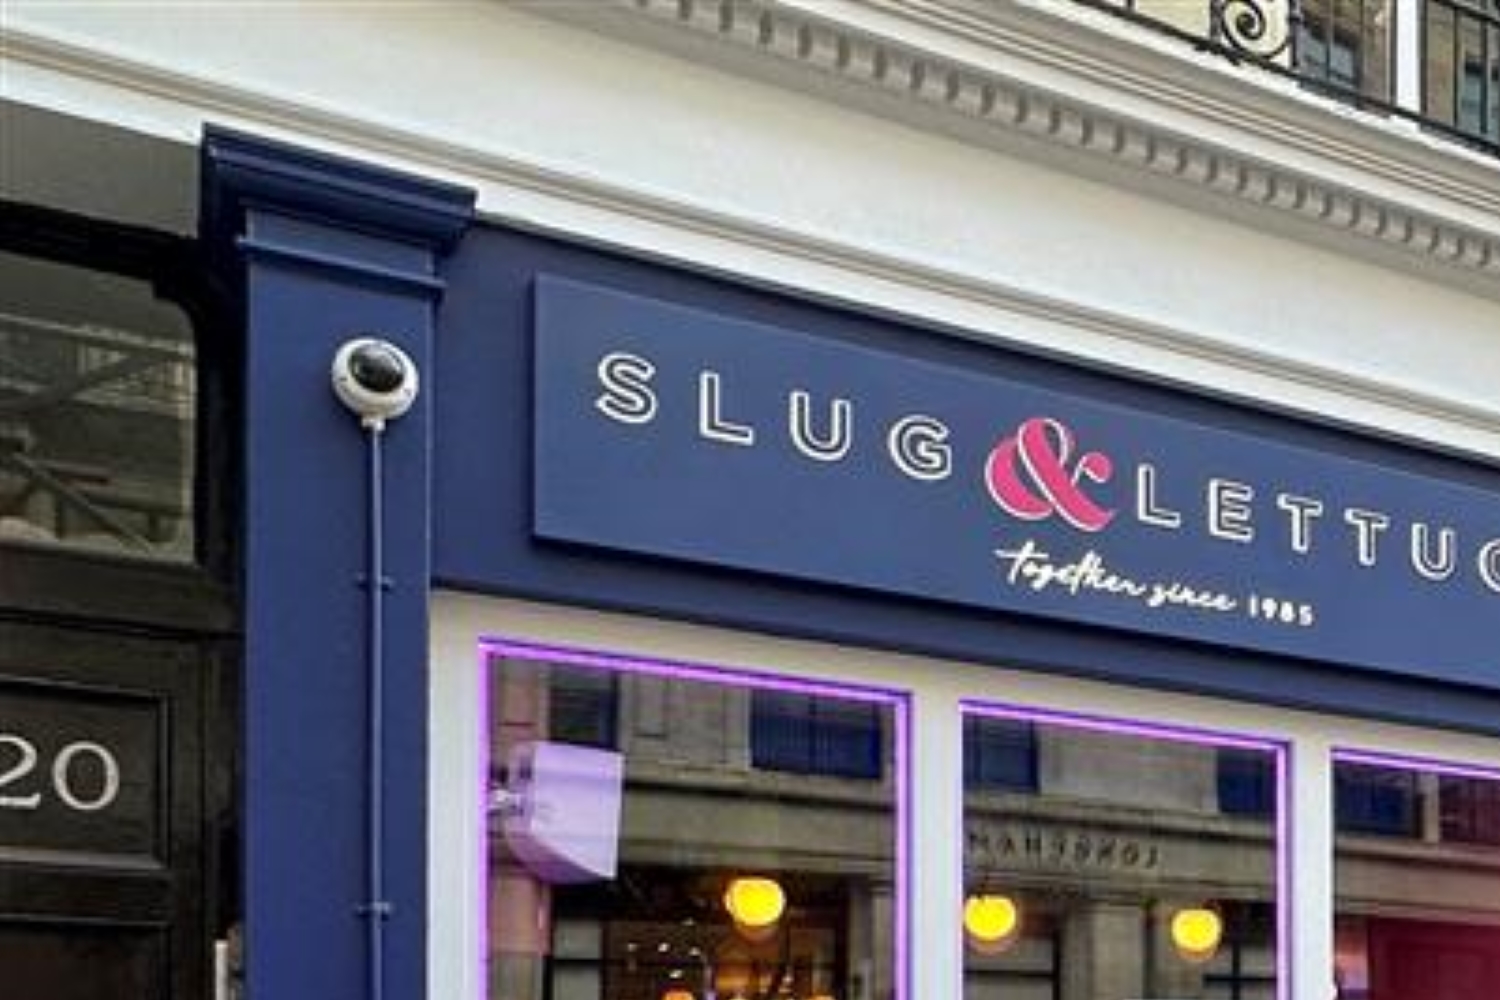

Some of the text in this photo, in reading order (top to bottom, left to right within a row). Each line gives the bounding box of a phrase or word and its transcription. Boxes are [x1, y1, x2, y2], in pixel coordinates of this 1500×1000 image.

[596, 352, 953, 481] SLUG
[984, 416, 1114, 533] &
[994, 539, 1314, 627] together since 1985
[0, 733, 120, 812] 20
